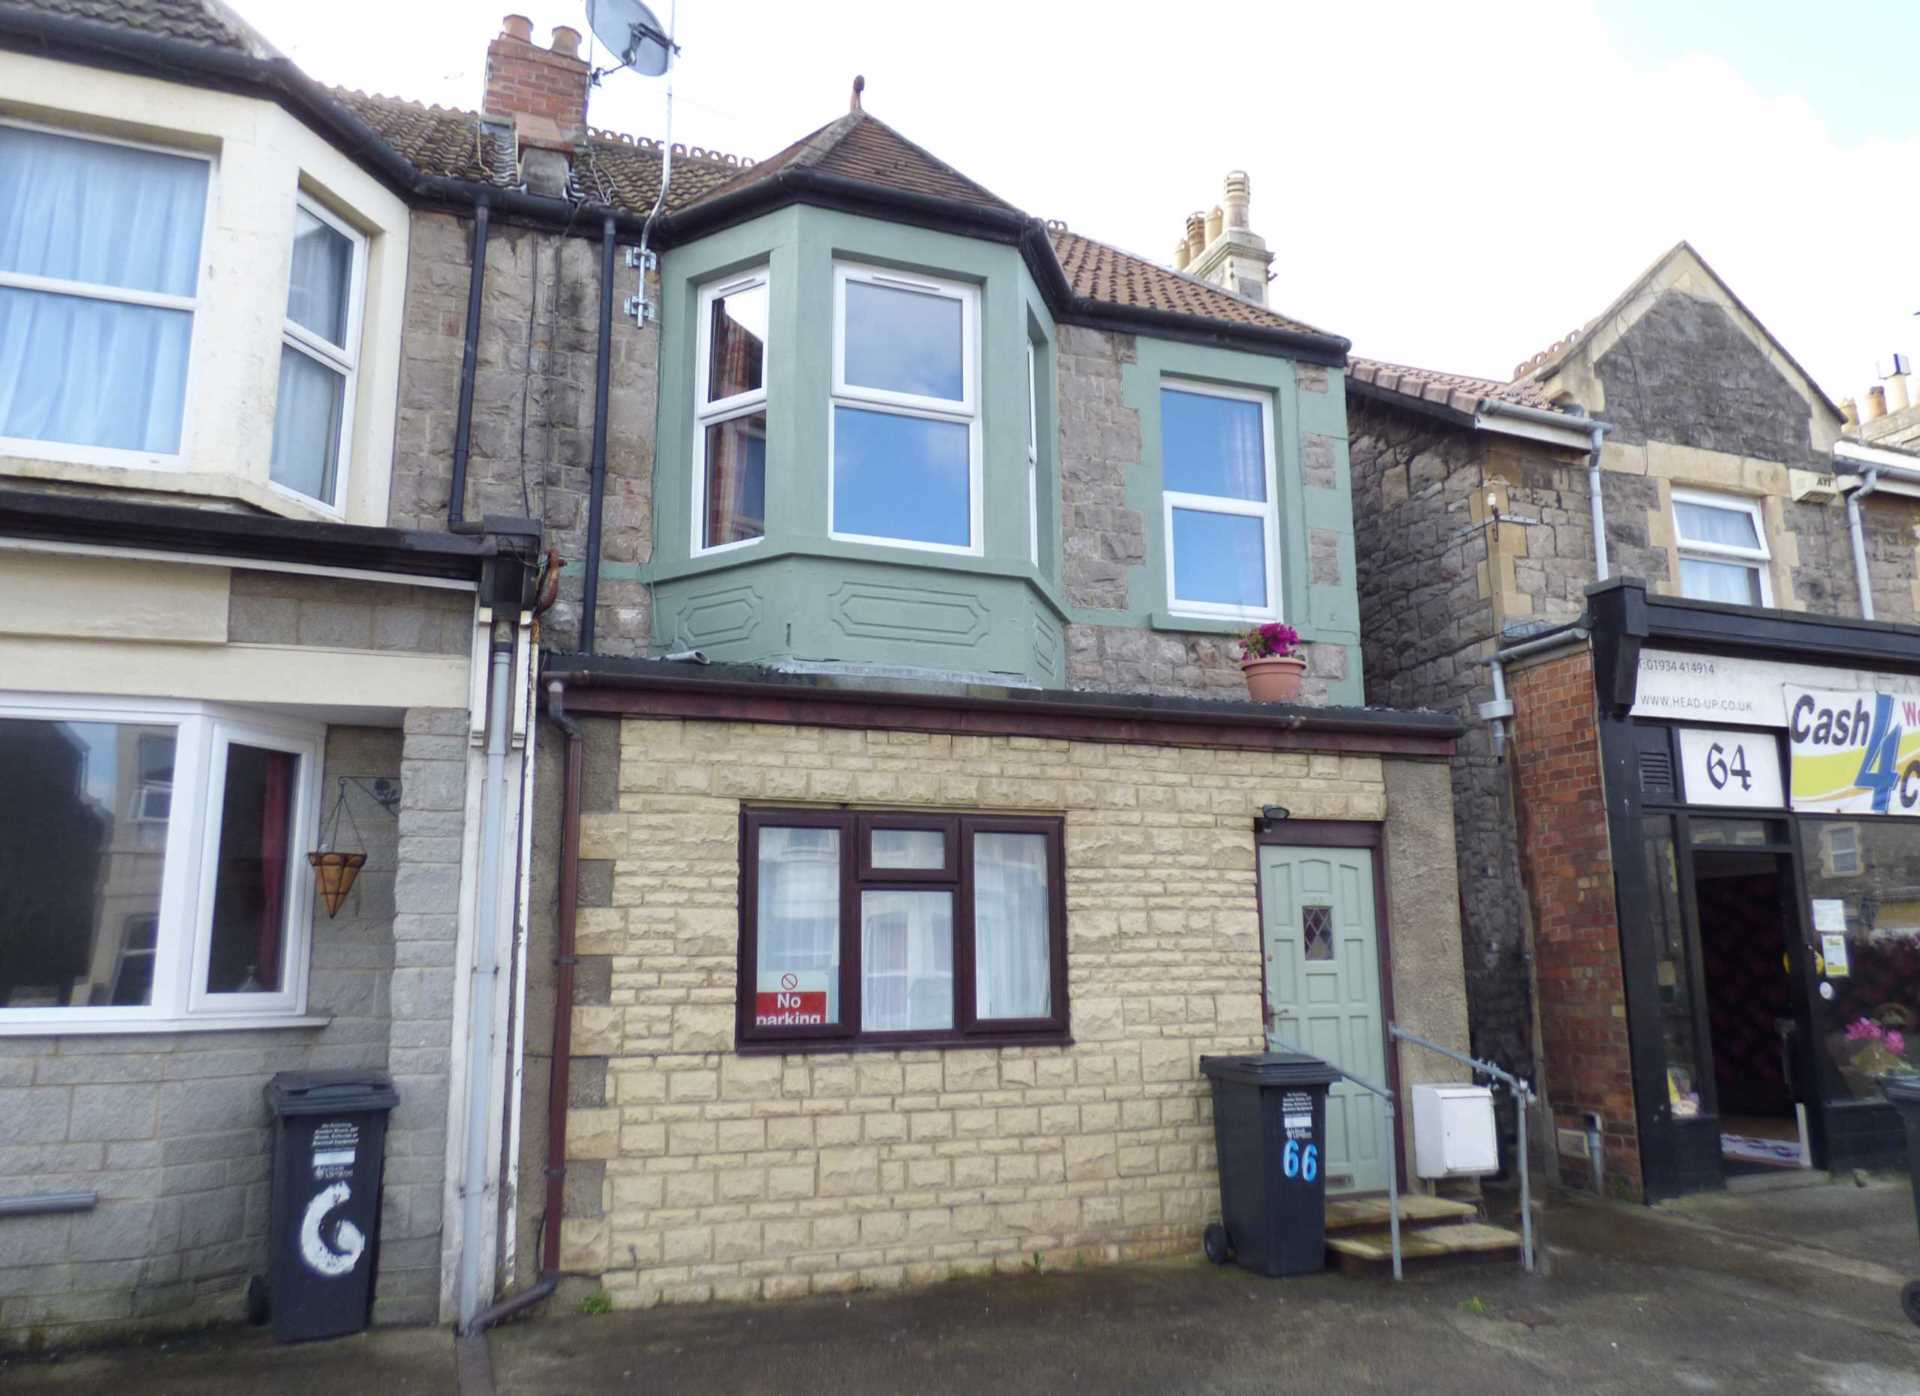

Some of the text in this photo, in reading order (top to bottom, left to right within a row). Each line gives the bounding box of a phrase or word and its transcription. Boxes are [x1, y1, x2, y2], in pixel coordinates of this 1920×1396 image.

[1679, 663, 1714, 674] 414914
[1706, 742, 1752, 791] 64
[1791, 694, 1870, 746] Cash
[1854, 693, 1902, 811] 4
[756, 1011, 821, 1025] parking
[777, 993, 802, 1009] No
[1283, 1139, 1318, 1182] 66
[301, 1180, 366, 1275] 6
